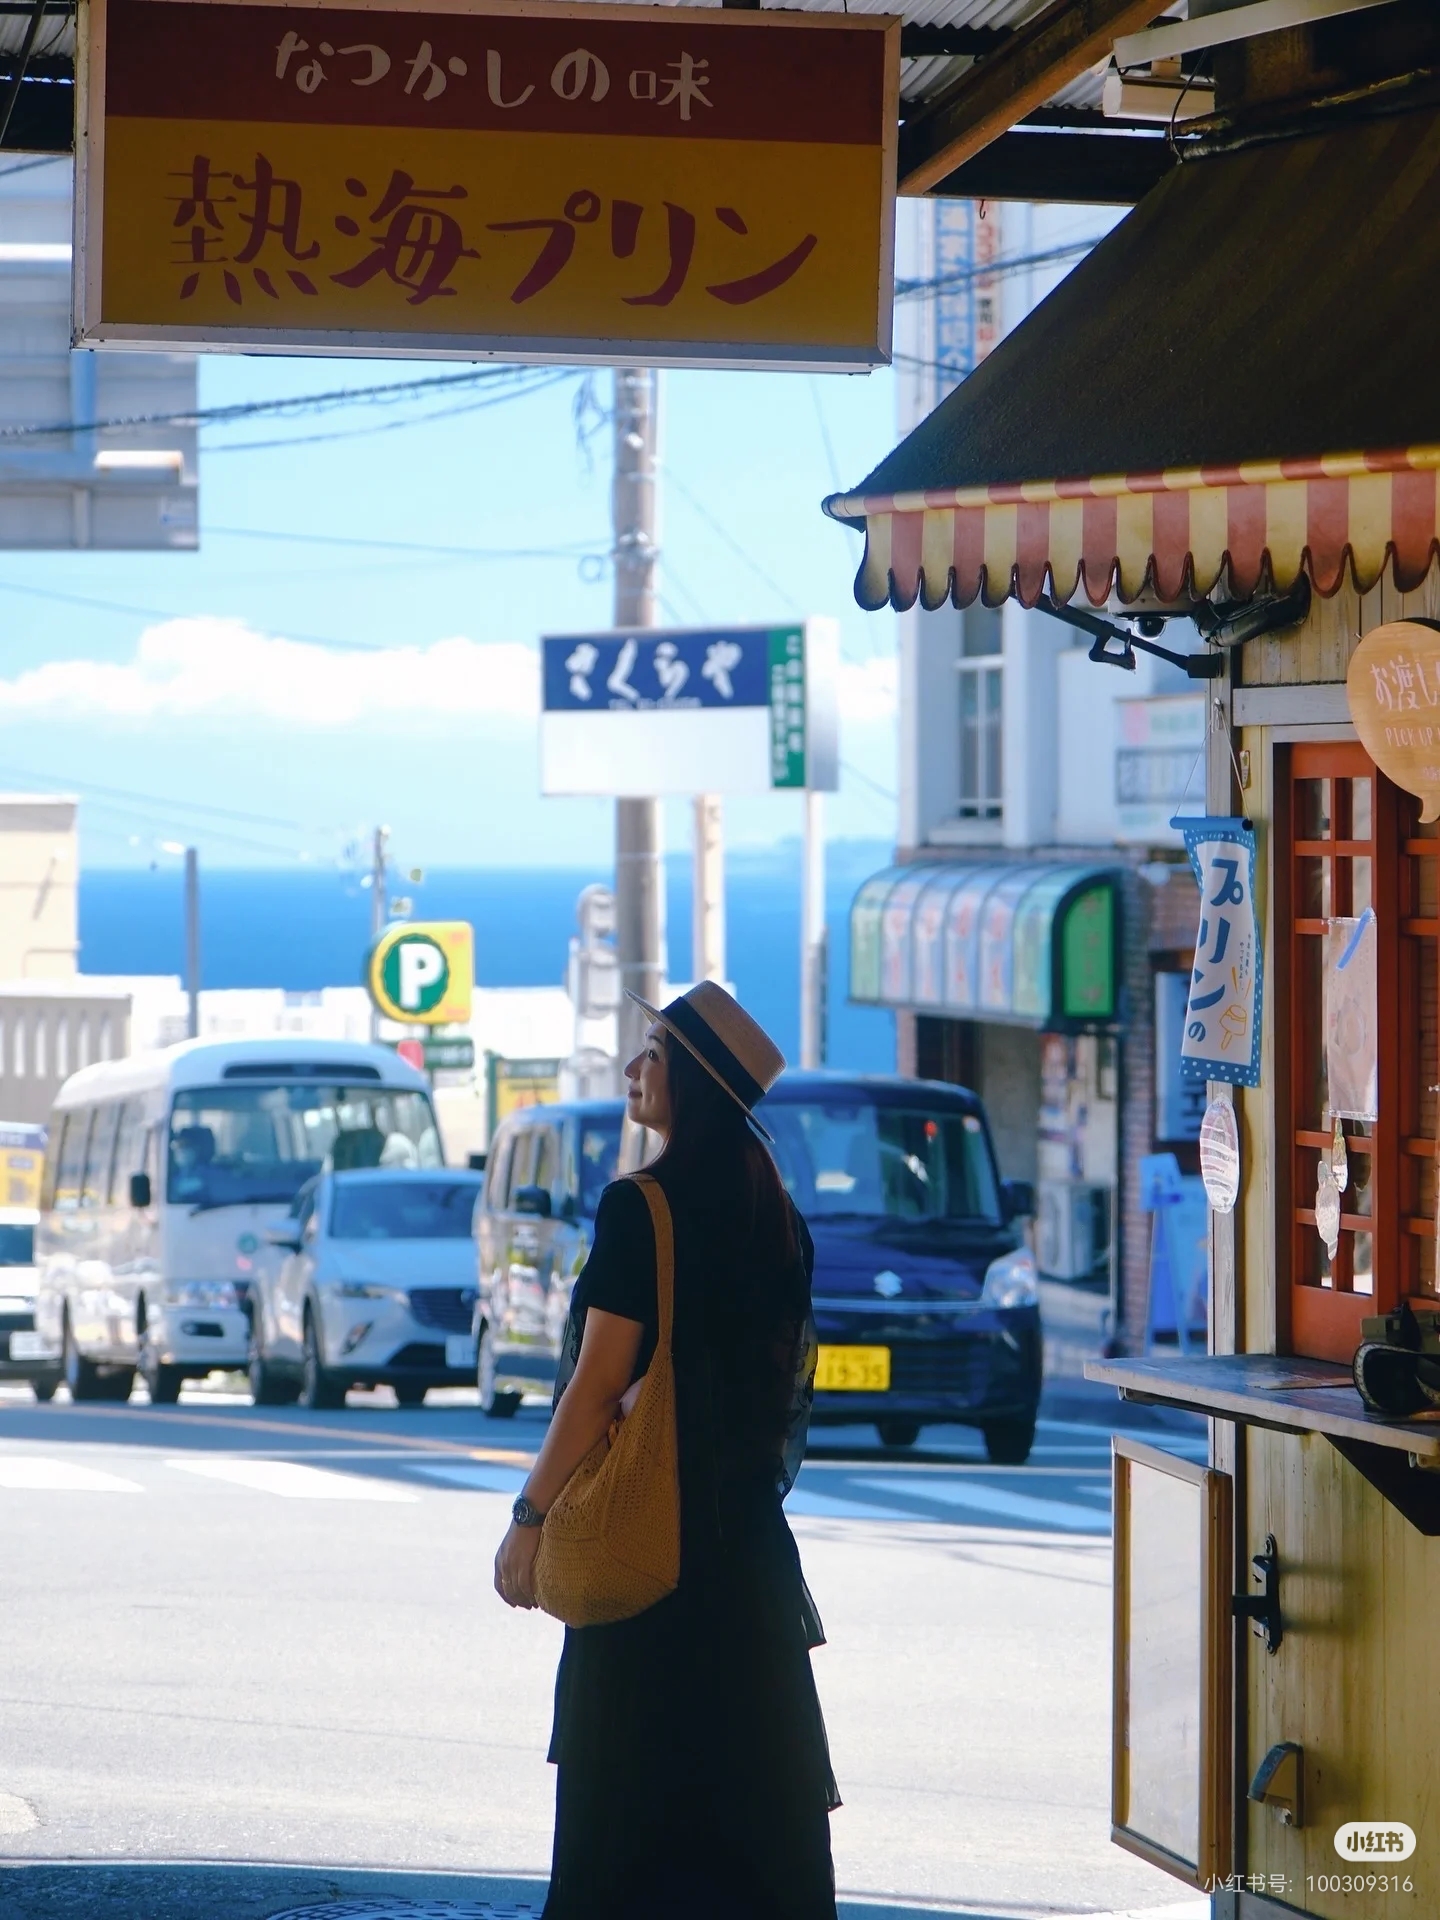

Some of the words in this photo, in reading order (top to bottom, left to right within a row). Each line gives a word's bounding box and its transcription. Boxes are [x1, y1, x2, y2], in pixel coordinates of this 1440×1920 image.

[275, 29, 712, 122] なつかしの味
[167, 152, 817, 306] 熱海プリン
[565, 637, 742, 702] さくらや
[1370, 655, 1440, 713] お渡し
[1386, 727, 1416, 748] PICK
[1419, 727, 1434, 747] UP
[399, 941, 444, 1009] P
[1188, 857, 1244, 1042] プリンの
